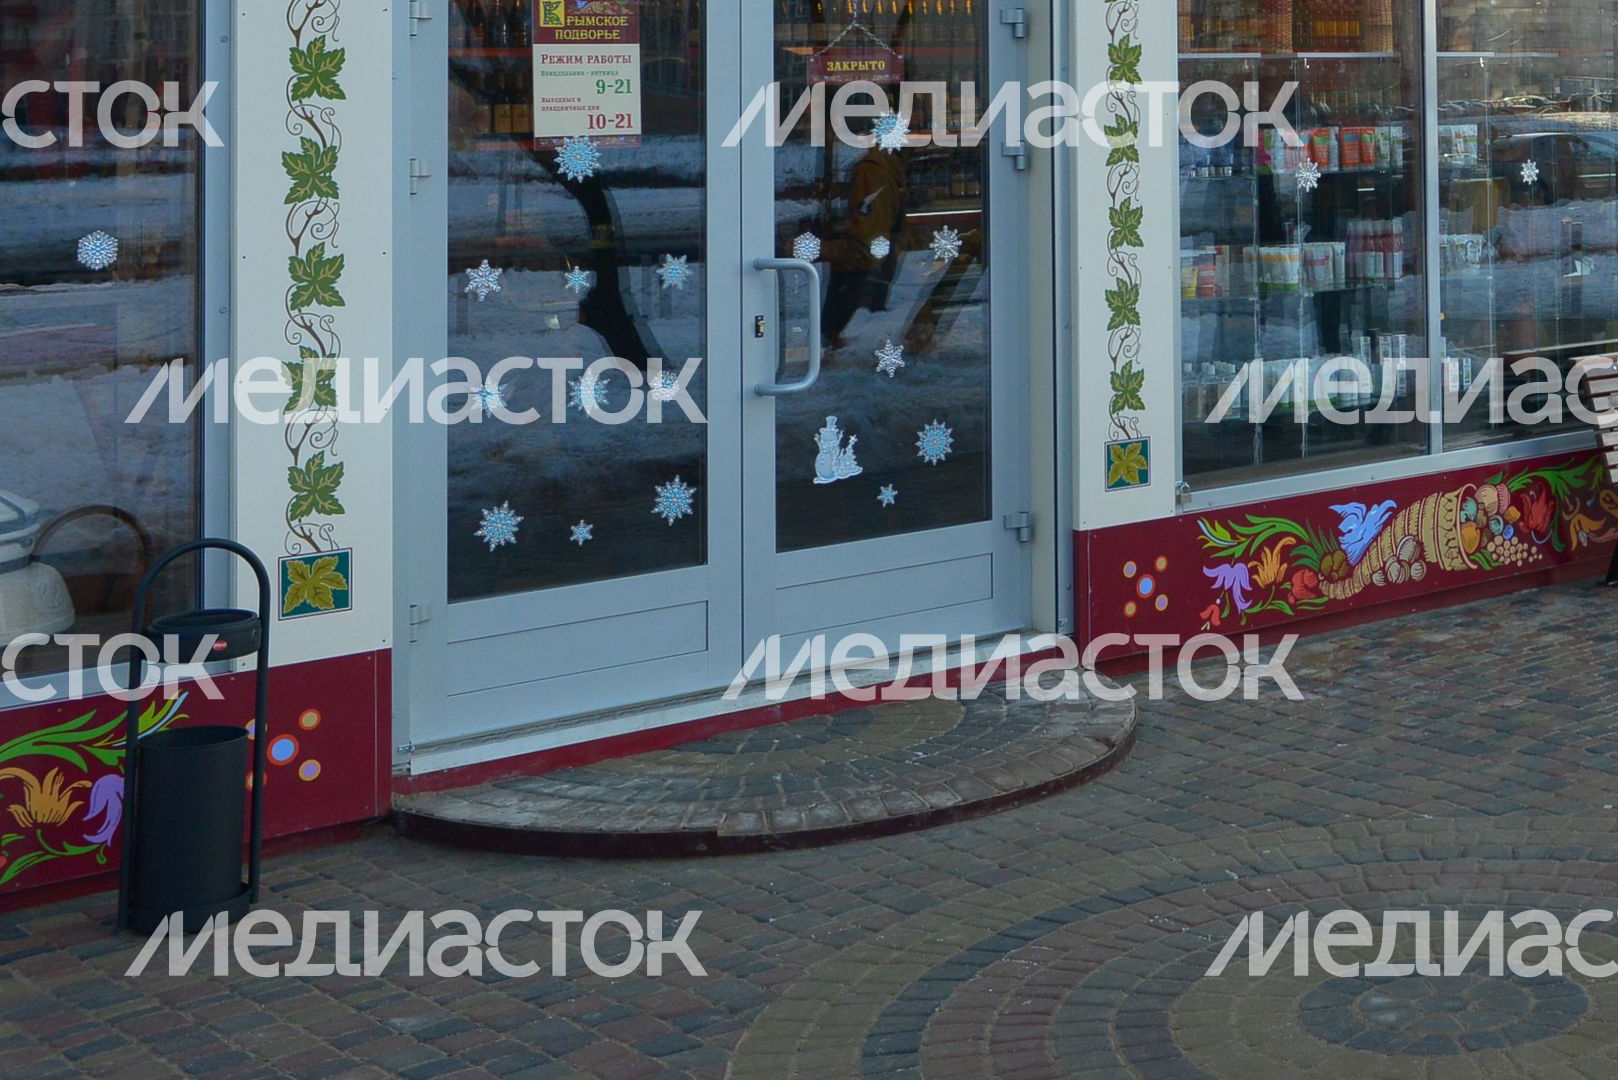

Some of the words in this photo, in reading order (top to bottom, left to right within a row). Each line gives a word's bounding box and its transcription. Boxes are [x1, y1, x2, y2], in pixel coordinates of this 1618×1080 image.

[555, 30, 620, 40] ПОДВОРЬЕ
[587, 54, 632, 64] РАБОТЫ
[827, 60, 885, 71] ЗАКРЫТО
[596, 79, 632, 94] 9-21
[587, 114, 633, 129] 10-21
